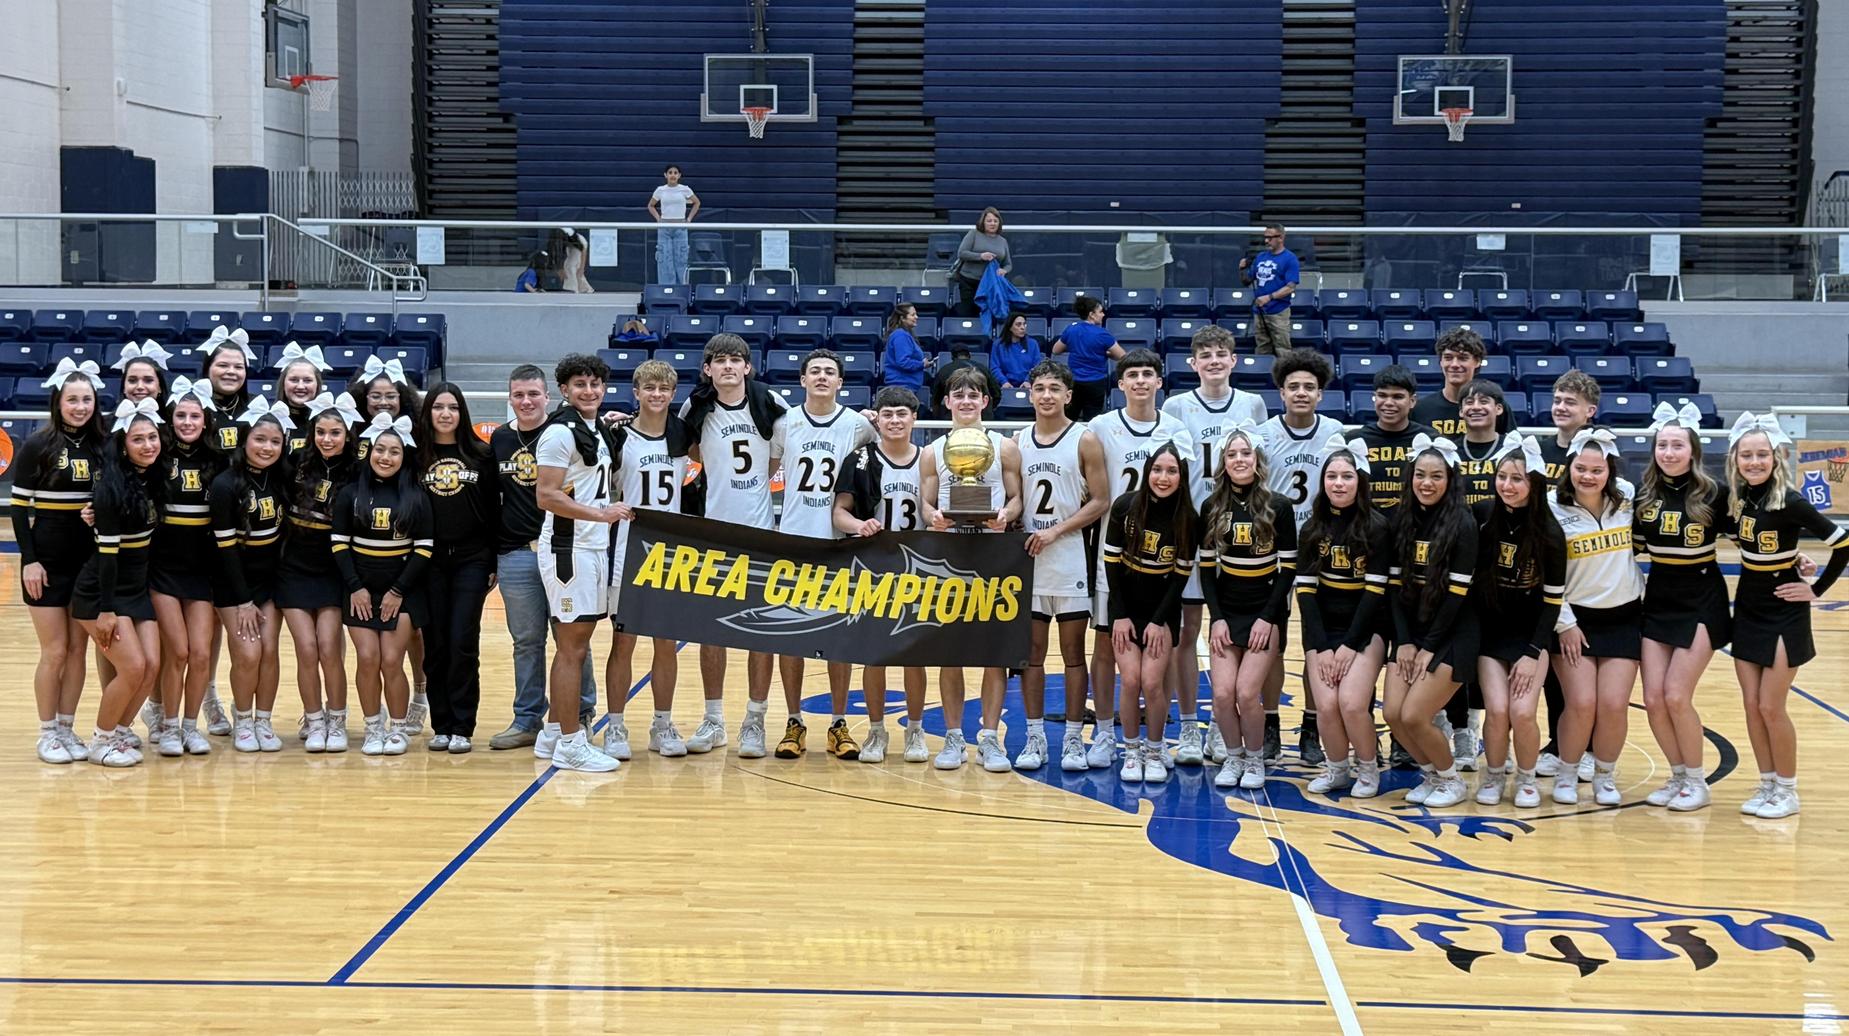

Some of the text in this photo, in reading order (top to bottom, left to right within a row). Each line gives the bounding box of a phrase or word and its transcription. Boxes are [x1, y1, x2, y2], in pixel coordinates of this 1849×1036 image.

[721, 423, 758, 438] SEMINOLE
[1432, 420, 1467, 434] SOA
[801, 440, 836, 454] SEMINOLE
[639, 453, 674, 468] SEMINOLE
[732, 439, 753, 474] 5
[1284, 454, 1320, 467] SEMINOLE
[500, 462, 518, 472] PLAY
[797, 456, 835, 492] 23
[1028, 462, 1061, 477] SEMINOLE
[1385, 467, 1400, 477] TO
[1460, 460, 1494, 475] SOA
[458, 470, 479, 482] OFFS
[730, 475, 758, 491] INDIANS
[637, 470, 674, 506] 15
[884, 481, 919, 497] SEMINOLE
[1291, 470, 1308, 505] 3
[1369, 481, 1405, 492] TRIUM
[1473, 480, 1488, 490] TO
[803, 495, 831, 508] INDIANS
[1036, 479, 1055, 515] 2
[1806, 485, 1825, 505] 15
[884, 498, 916, 531] 13
[1572, 530, 1632, 554] SEMINOLE
[632, 542, 1023, 624] AREA CHAMPIONS
